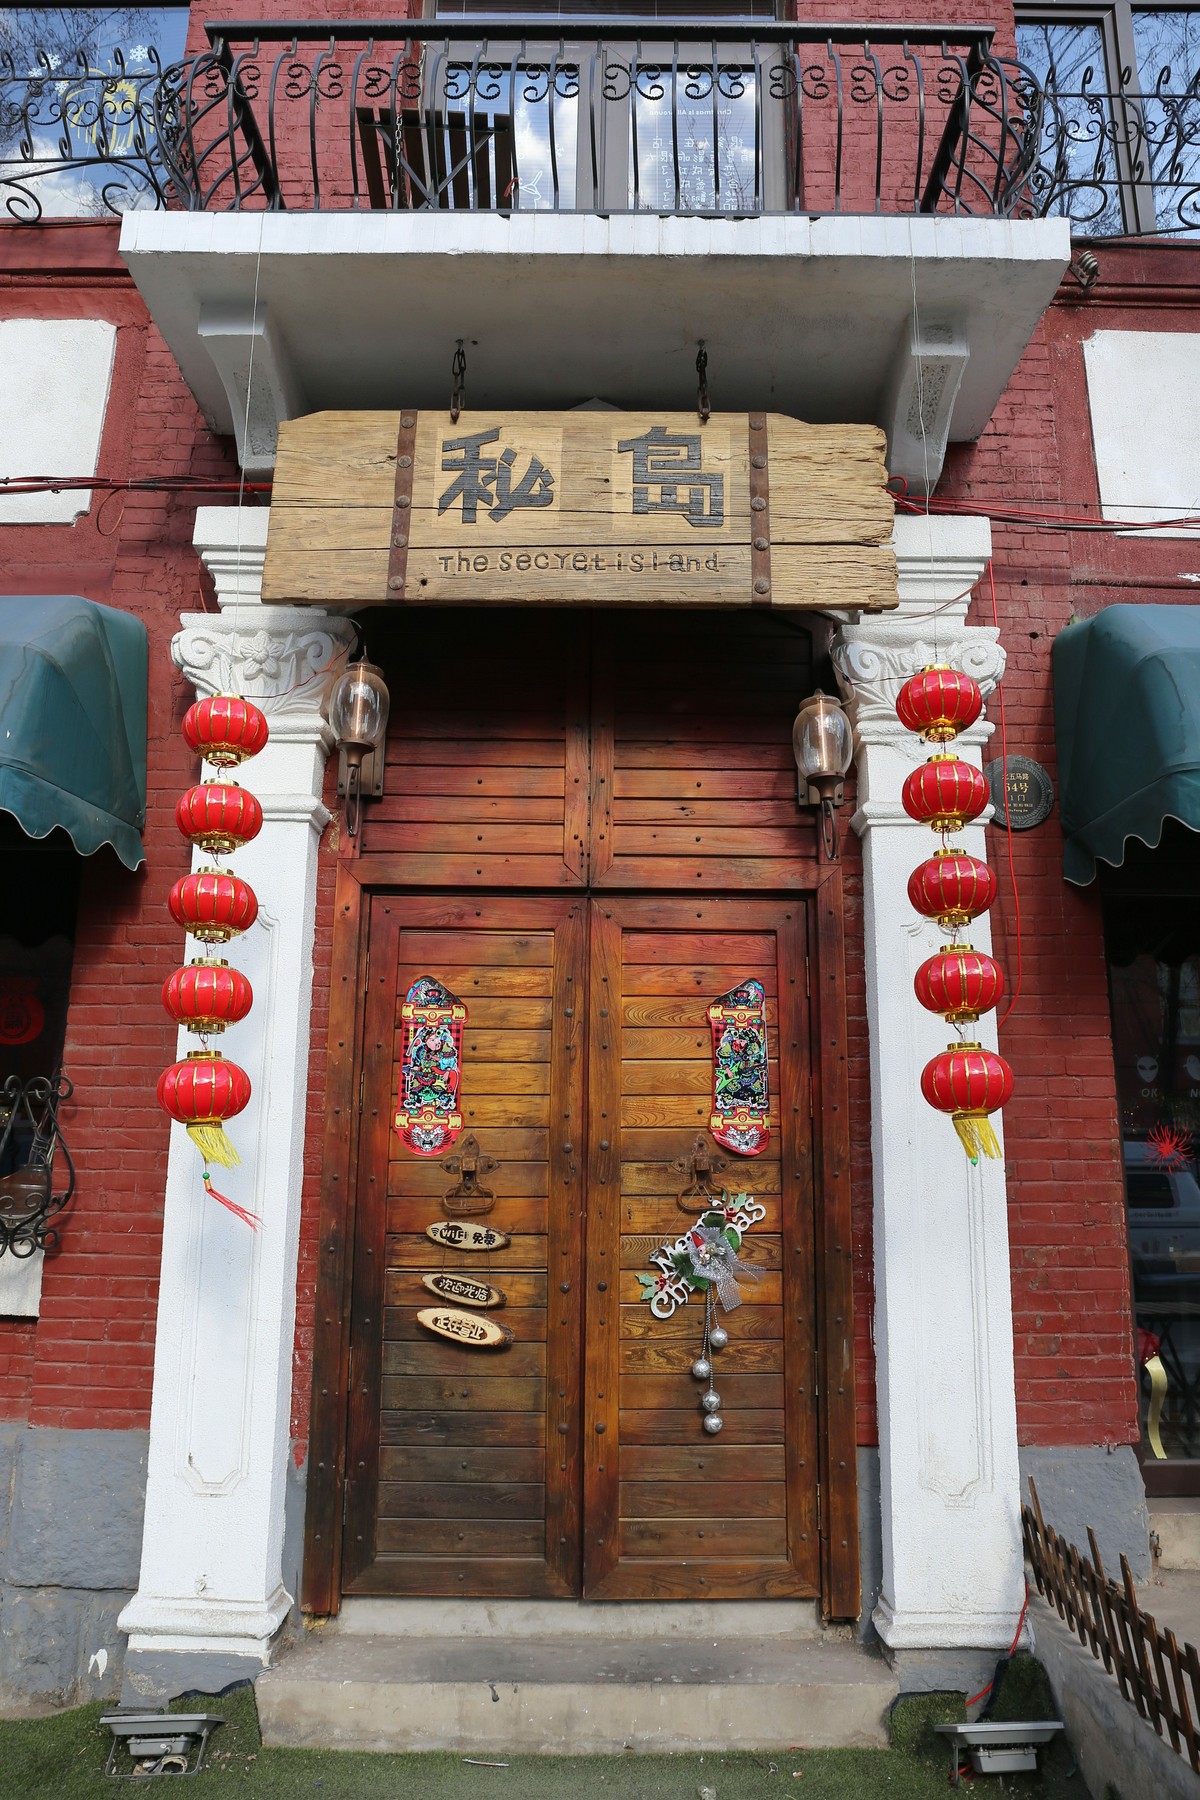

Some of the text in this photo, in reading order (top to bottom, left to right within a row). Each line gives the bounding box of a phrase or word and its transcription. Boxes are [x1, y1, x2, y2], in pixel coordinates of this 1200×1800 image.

[438, 551, 489, 572] The
[1141, 1088, 1159, 1098] OK
[1190, 1088, 1200, 1098] N
[439, 1278, 489, 1301] 欢迎光临
[435, 1314, 484, 1340] 正在营业
